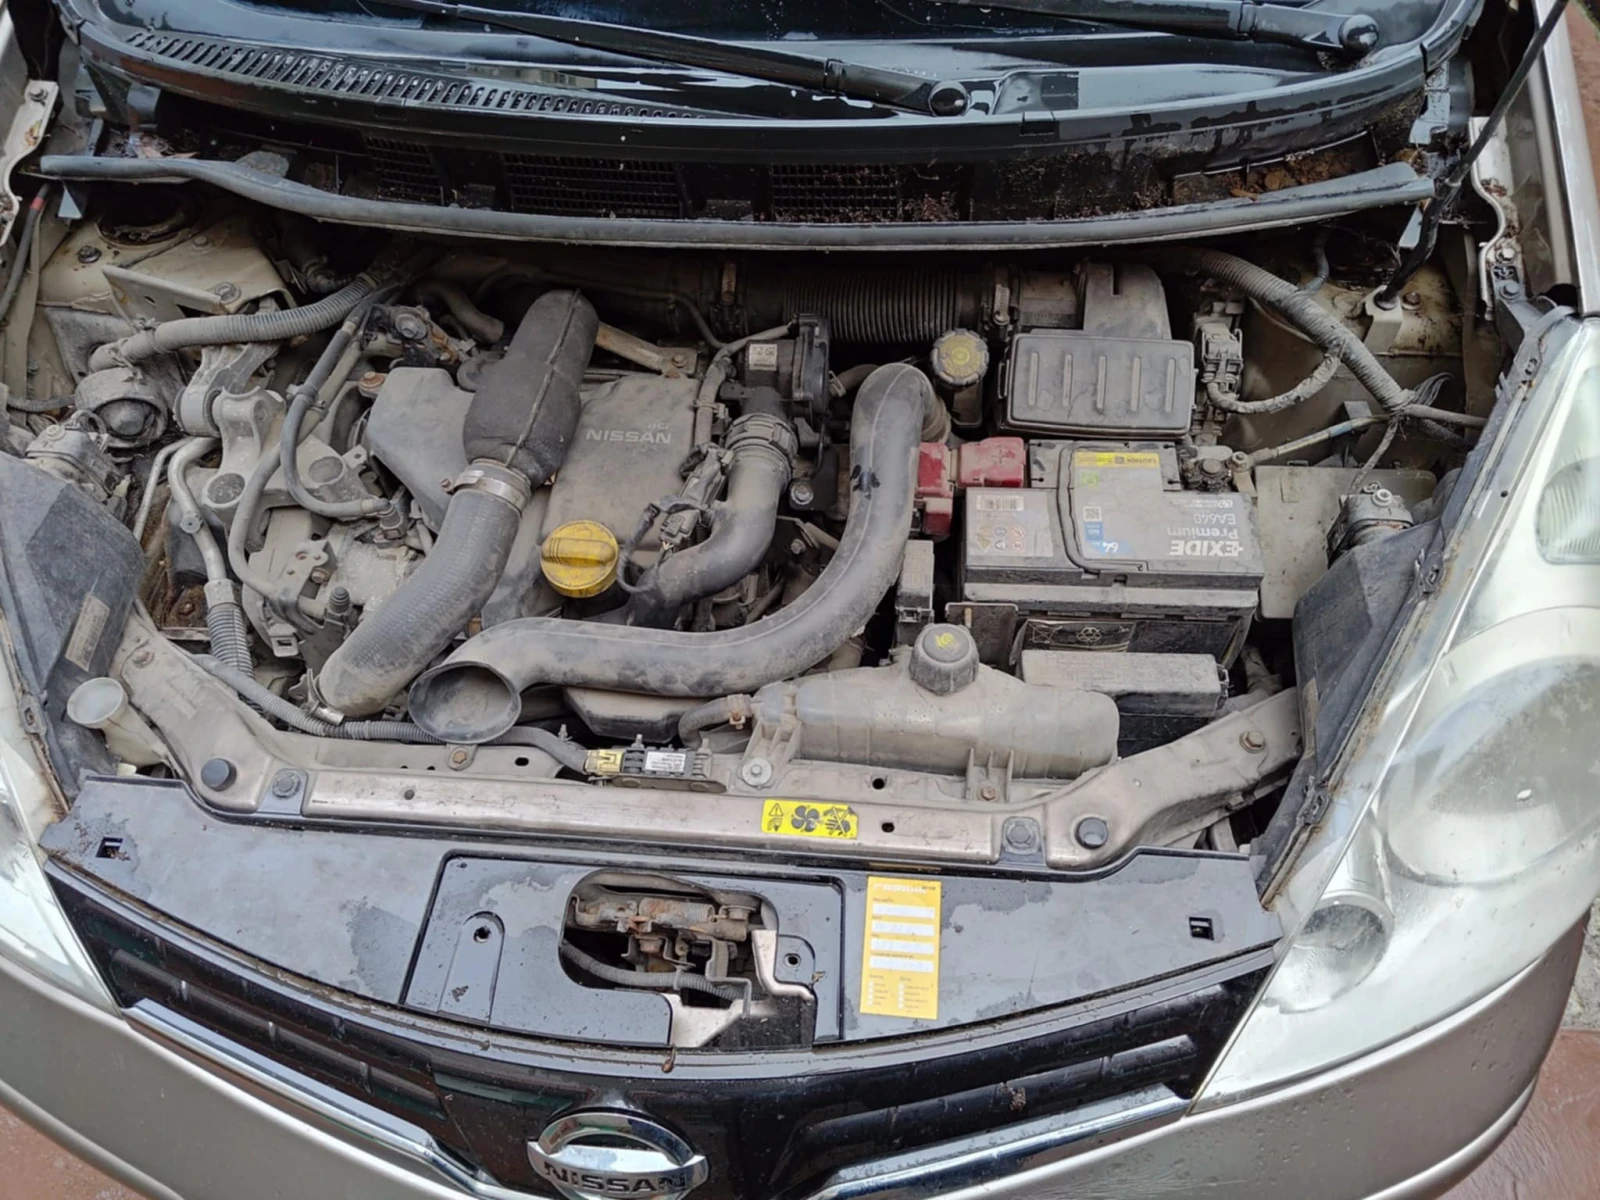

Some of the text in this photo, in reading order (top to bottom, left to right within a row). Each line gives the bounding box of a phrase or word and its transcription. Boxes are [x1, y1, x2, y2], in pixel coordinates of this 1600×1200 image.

[586, 428, 672, 444] NISSAN
[1194, 513, 1237, 525] EA640
[1167, 527, 1239, 540] Premium
[1169, 539, 1244, 557] EXIDE
[543, 1160, 688, 1194] NISSAN
